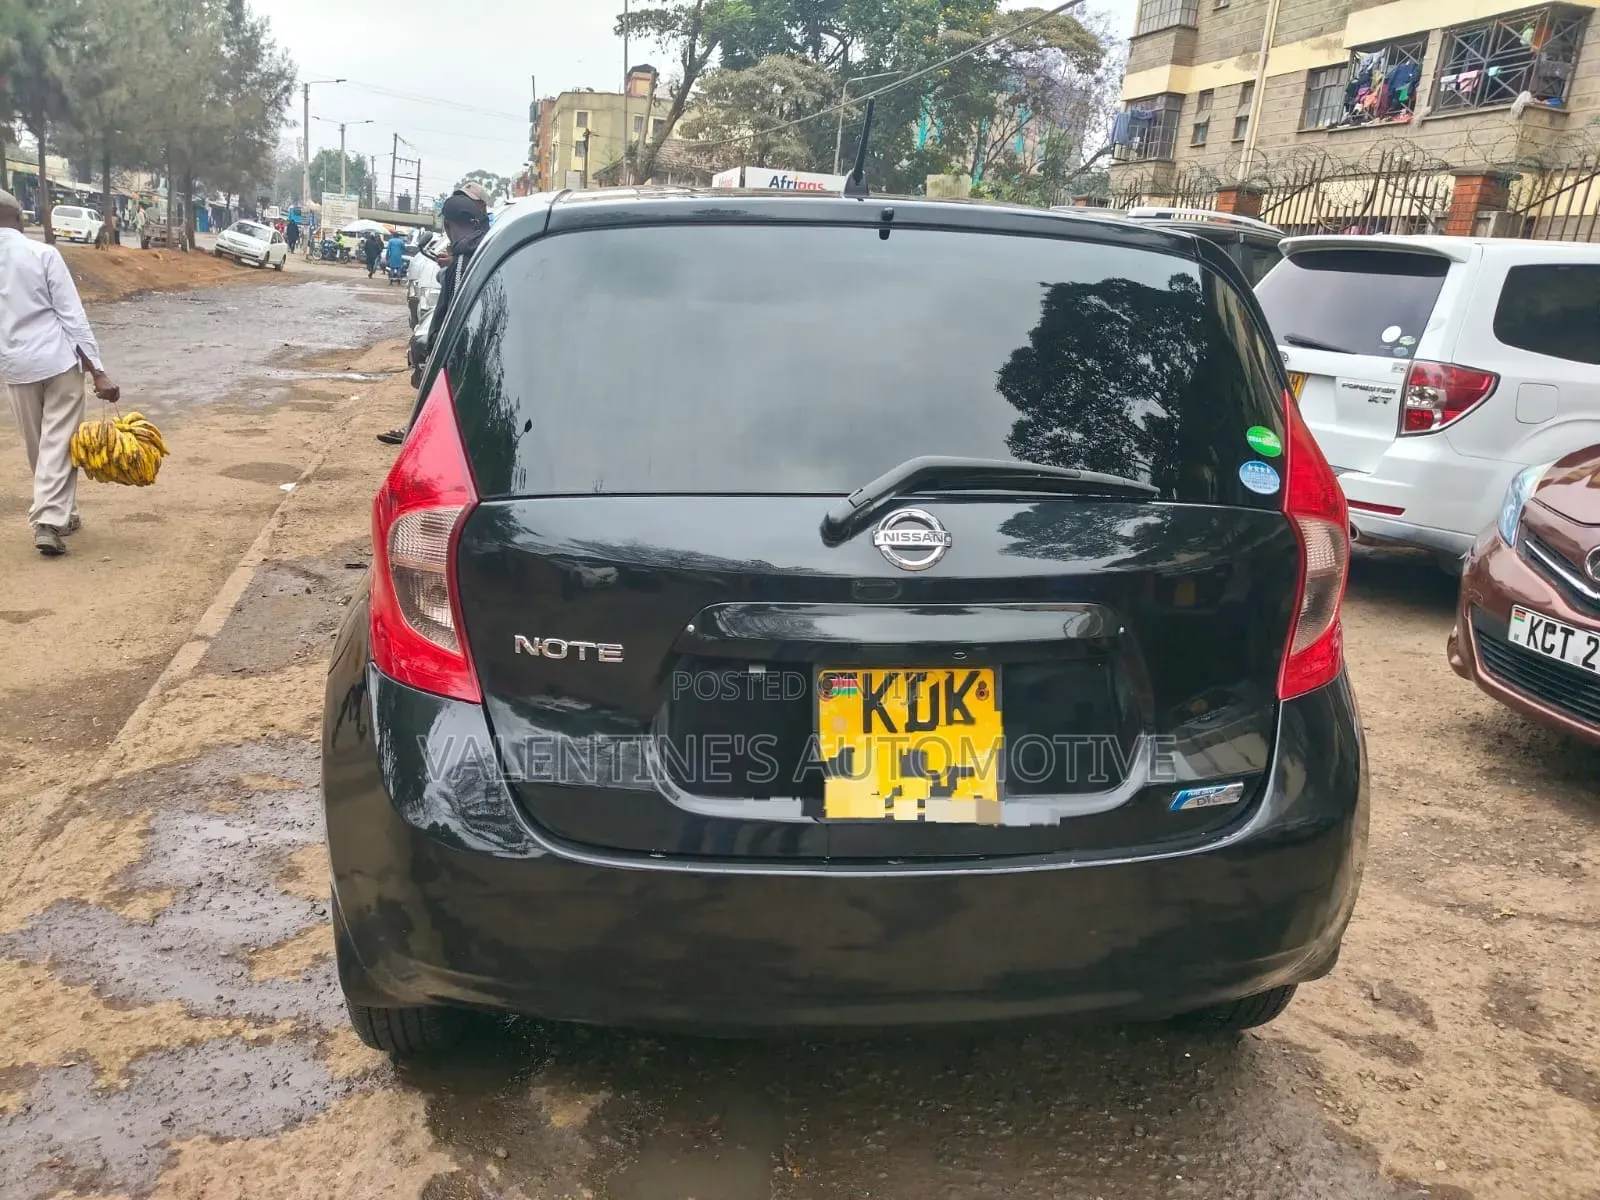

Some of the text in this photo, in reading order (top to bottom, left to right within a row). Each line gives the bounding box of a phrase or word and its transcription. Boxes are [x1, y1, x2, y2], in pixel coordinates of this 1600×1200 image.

[883, 532, 944, 543] NISSAN
[514, 634, 624, 662] NOTE
[1526, 615, 1576, 660] KCT
